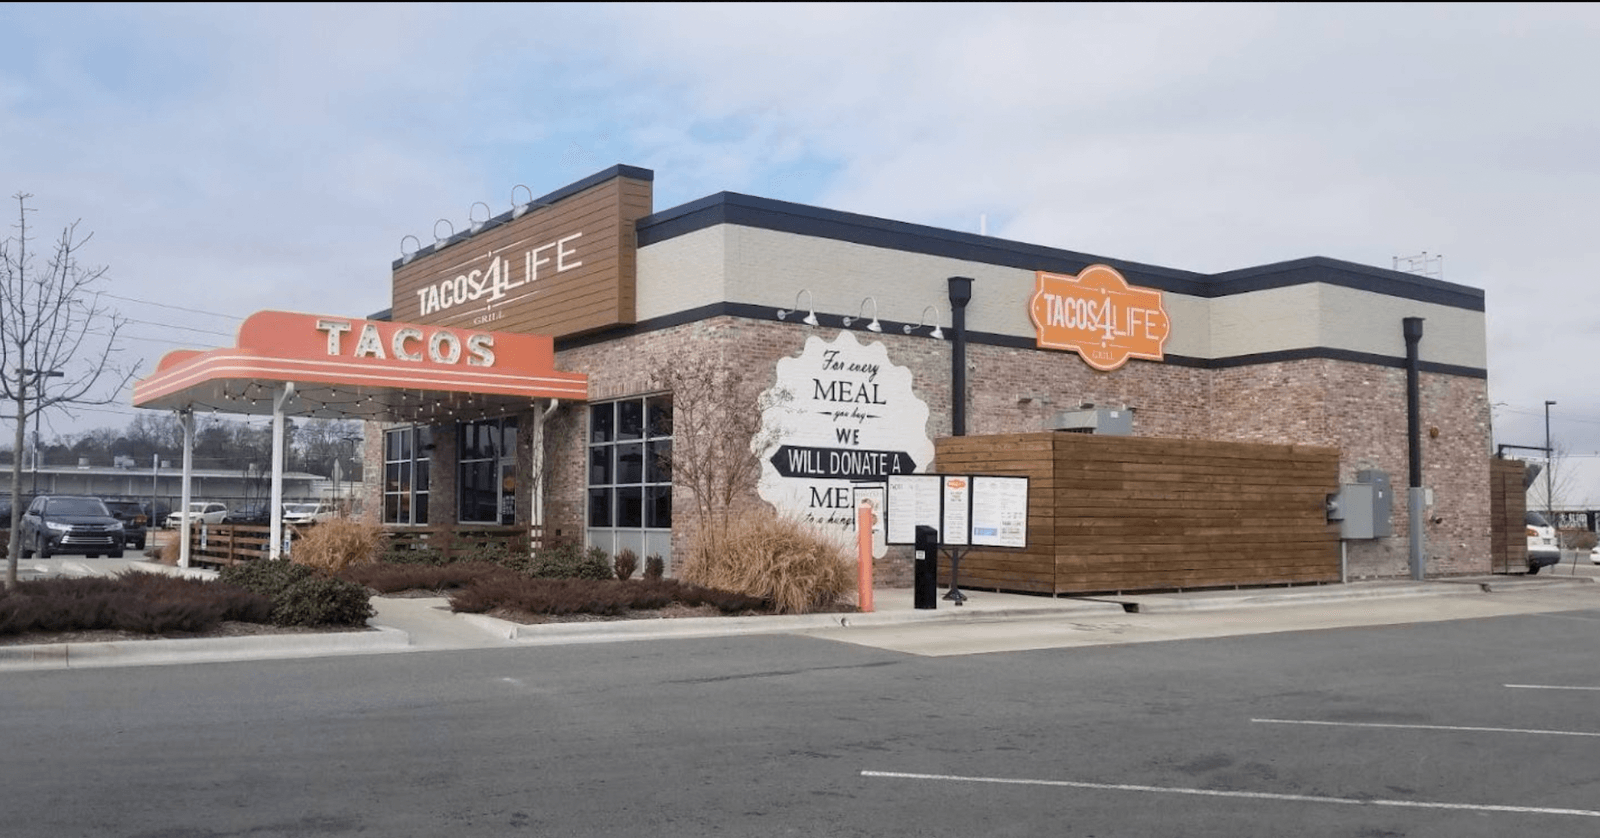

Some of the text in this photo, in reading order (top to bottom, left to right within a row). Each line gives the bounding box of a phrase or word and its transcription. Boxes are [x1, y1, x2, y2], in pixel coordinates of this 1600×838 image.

[473, 311, 505, 325] GRILL
[316, 319, 495, 367] TACOS
[822, 349, 880, 383] For every
[812, 378, 887, 405] MEAL
[850, 407, 866, 424] buy
[836, 428, 860, 445] WE
[788, 449, 901, 475] WILL DONATE A
[809, 485, 854, 508] ME
